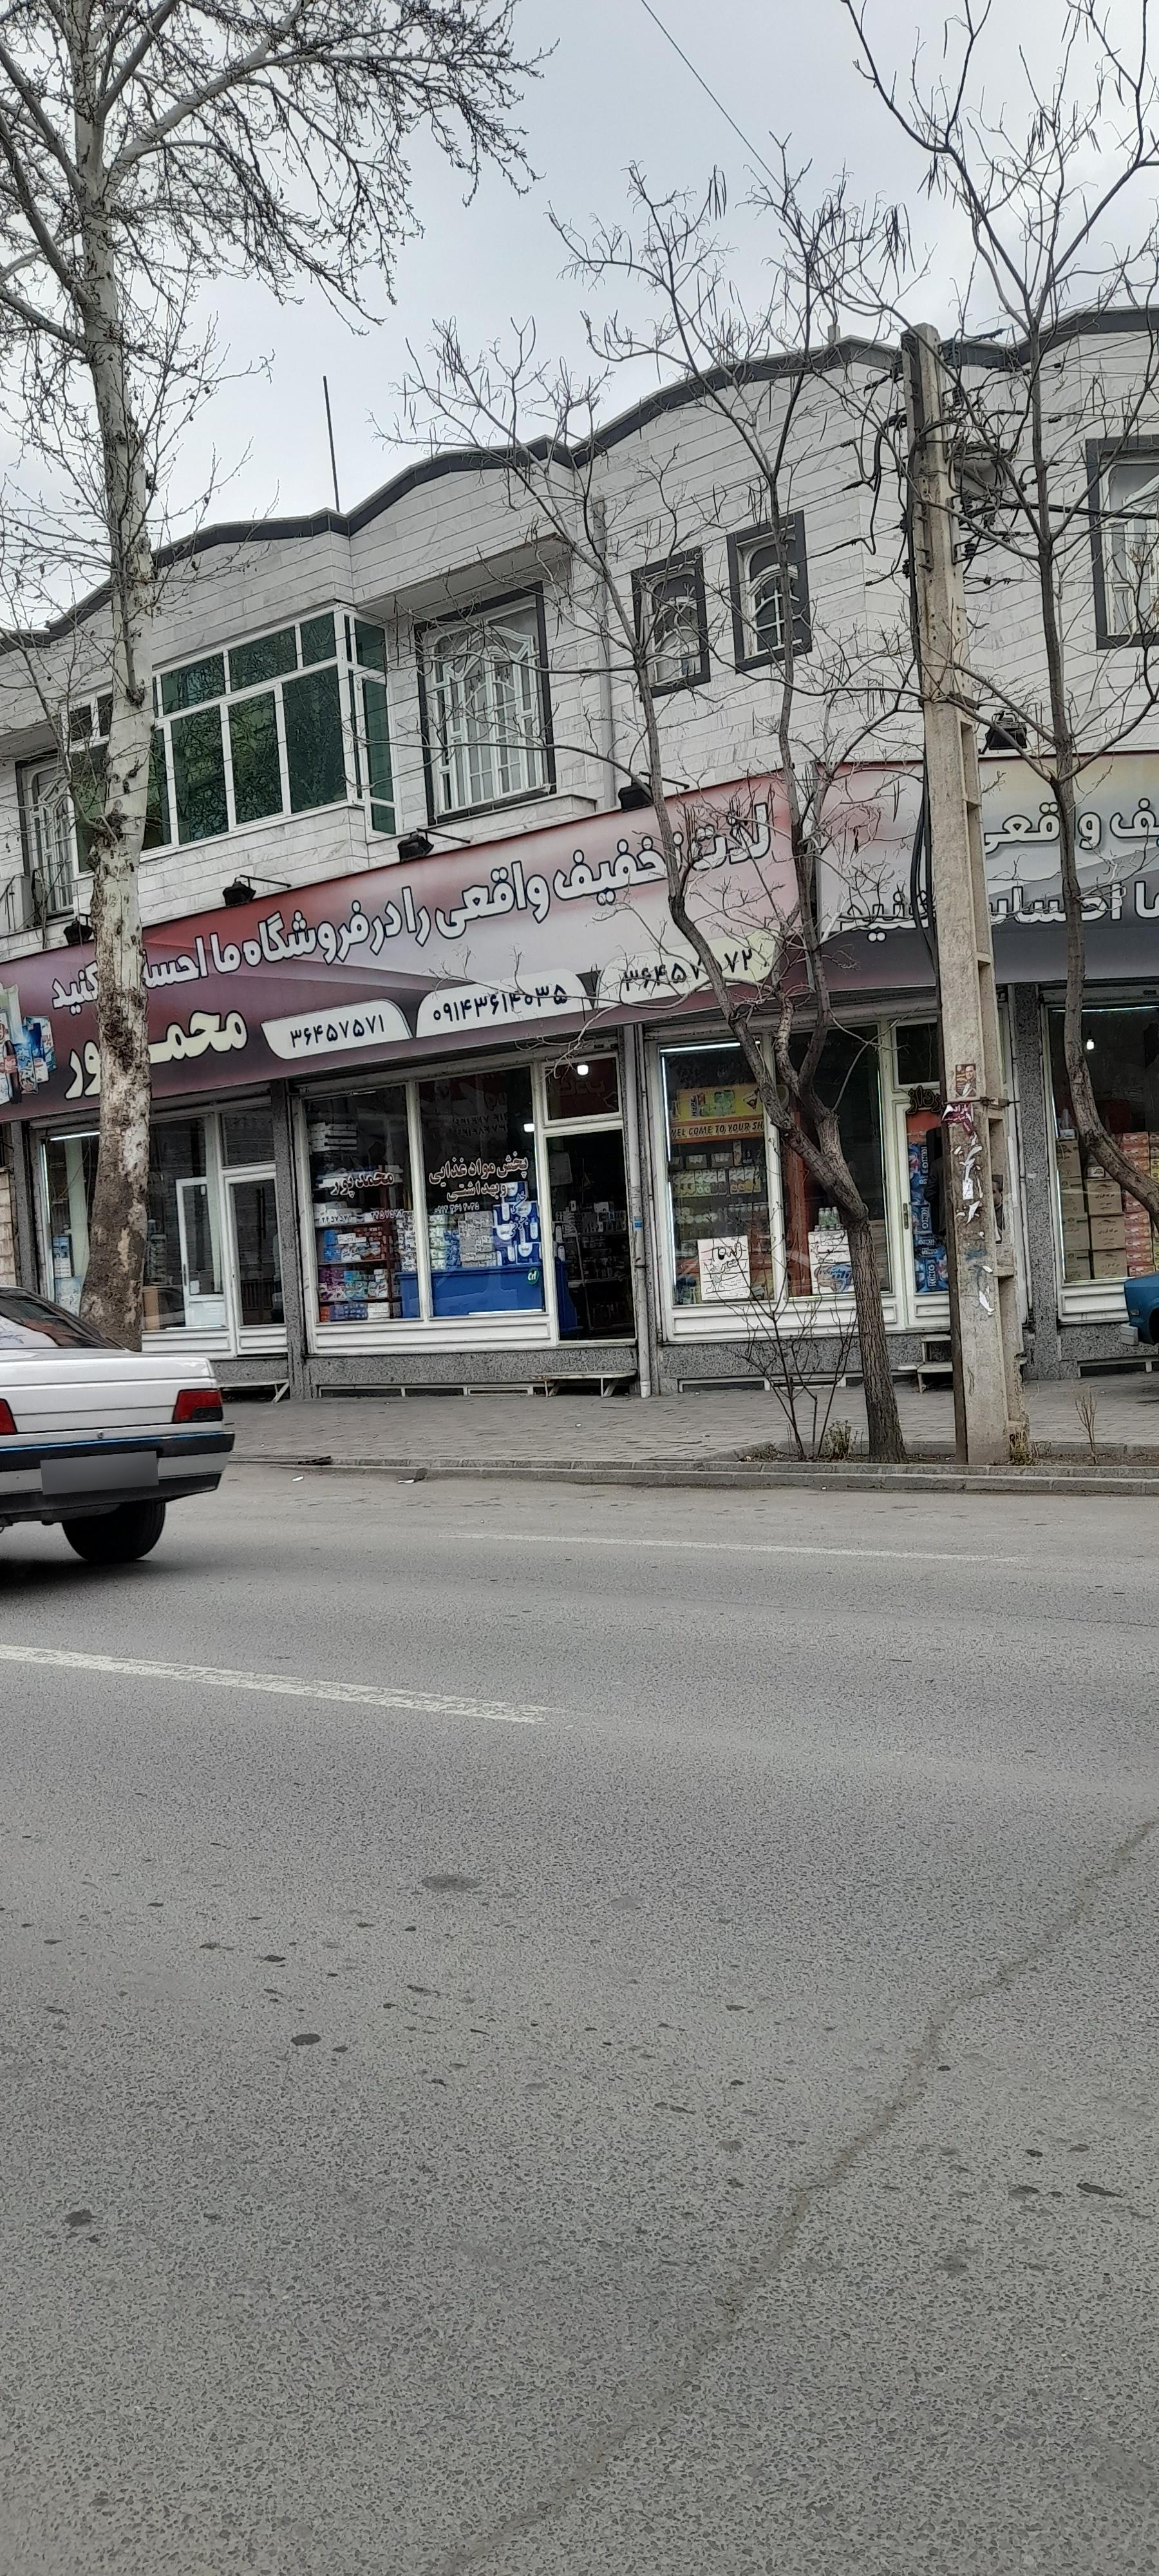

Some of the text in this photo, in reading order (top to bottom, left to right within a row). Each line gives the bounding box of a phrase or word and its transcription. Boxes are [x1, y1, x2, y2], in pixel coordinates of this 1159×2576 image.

[985, 802, 1102, 855] وقع
[402, 886, 431, 947] را
[435, 860, 550, 940] واقعی
[209, 932, 241, 974] ما
[242, 900, 370, 967] فروشگاه
[370, 901, 402, 955] در
[142, 935, 209, 989] احس
[623, 947, 753, 992] ۳۶۴۵۷۷۲
[433, 984, 568, 1022] ۰۹۱۴۳۶۱۴۰۳۵
[65, 1010, 248, 1099] محم ور
[290, 1014, 385, 1048] ۳۶۴۵۷۵۷۱
[753, 1120, 764, 1131] SH
[429, 1151, 529, 1188] پخش مواد غذایی
